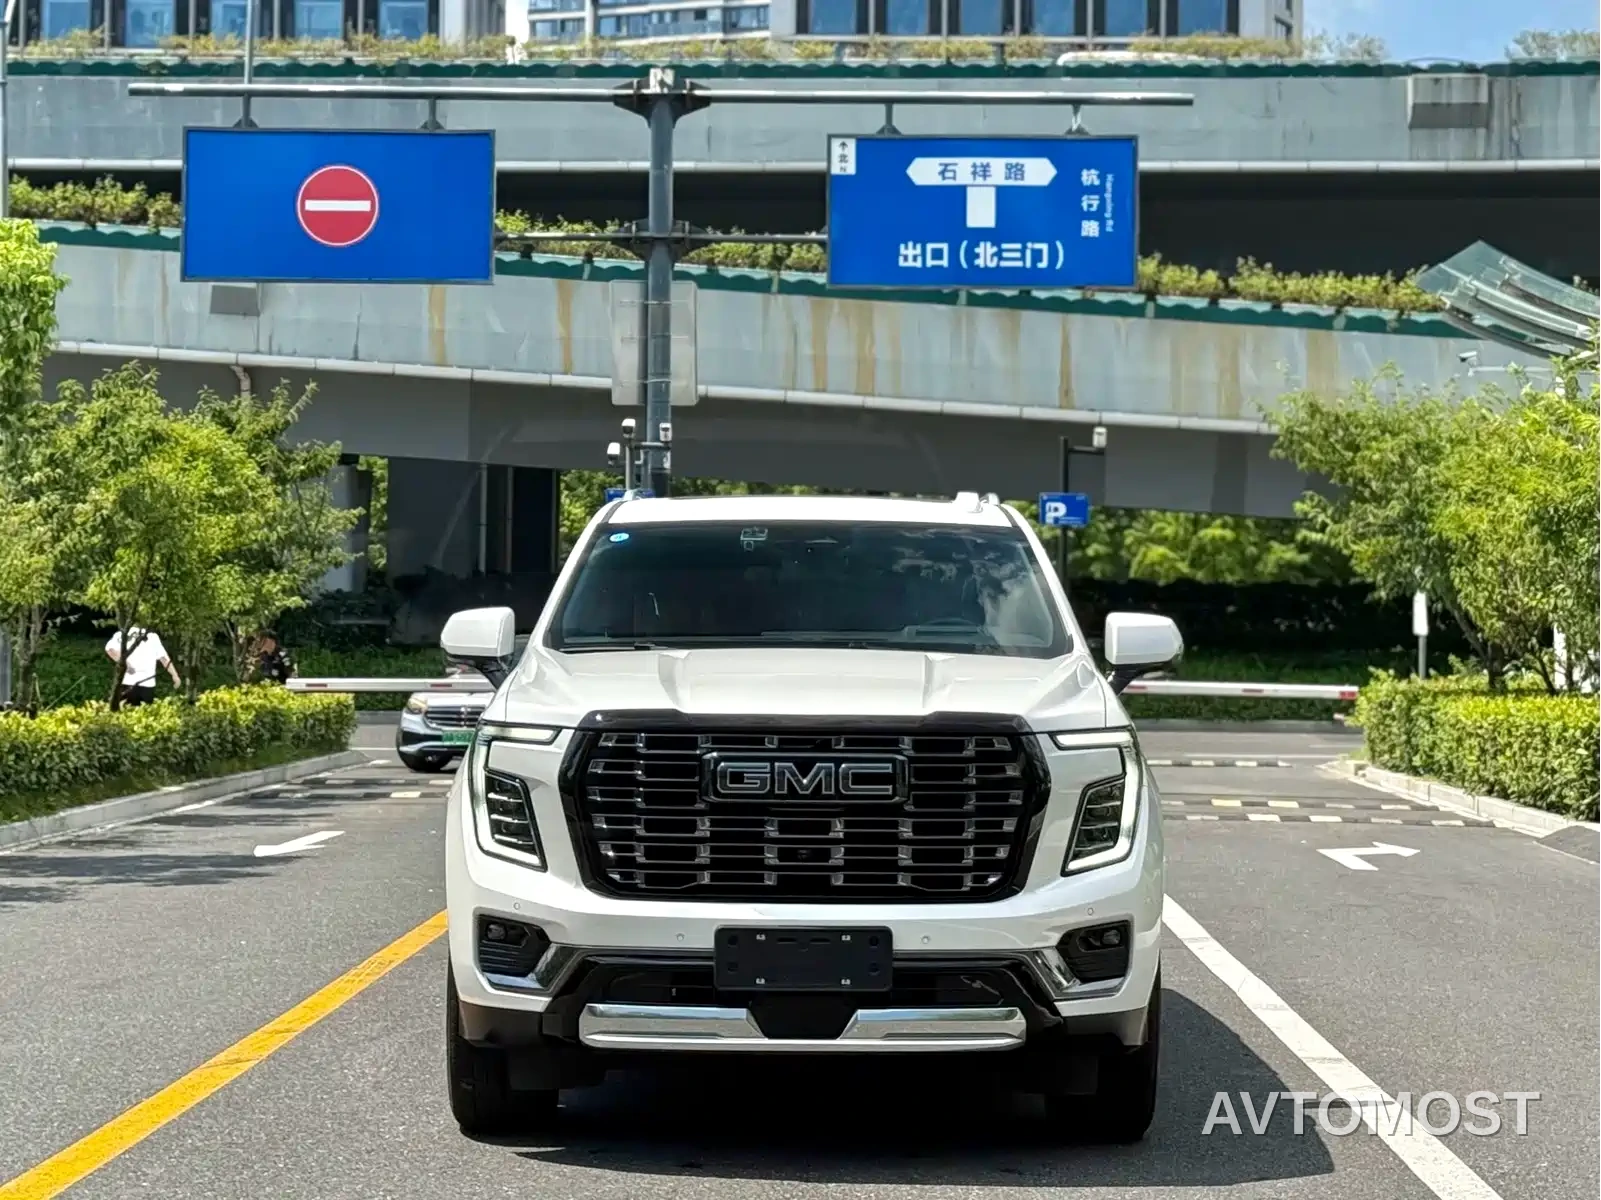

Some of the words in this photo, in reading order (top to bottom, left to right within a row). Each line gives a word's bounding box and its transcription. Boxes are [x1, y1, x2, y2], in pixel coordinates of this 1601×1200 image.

[837, 153, 849, 164] 北
[938, 161, 1026, 182] 石祥路
[1080, 168, 1101, 238] 杭行路
[717, 762, 893, 795] GMC
